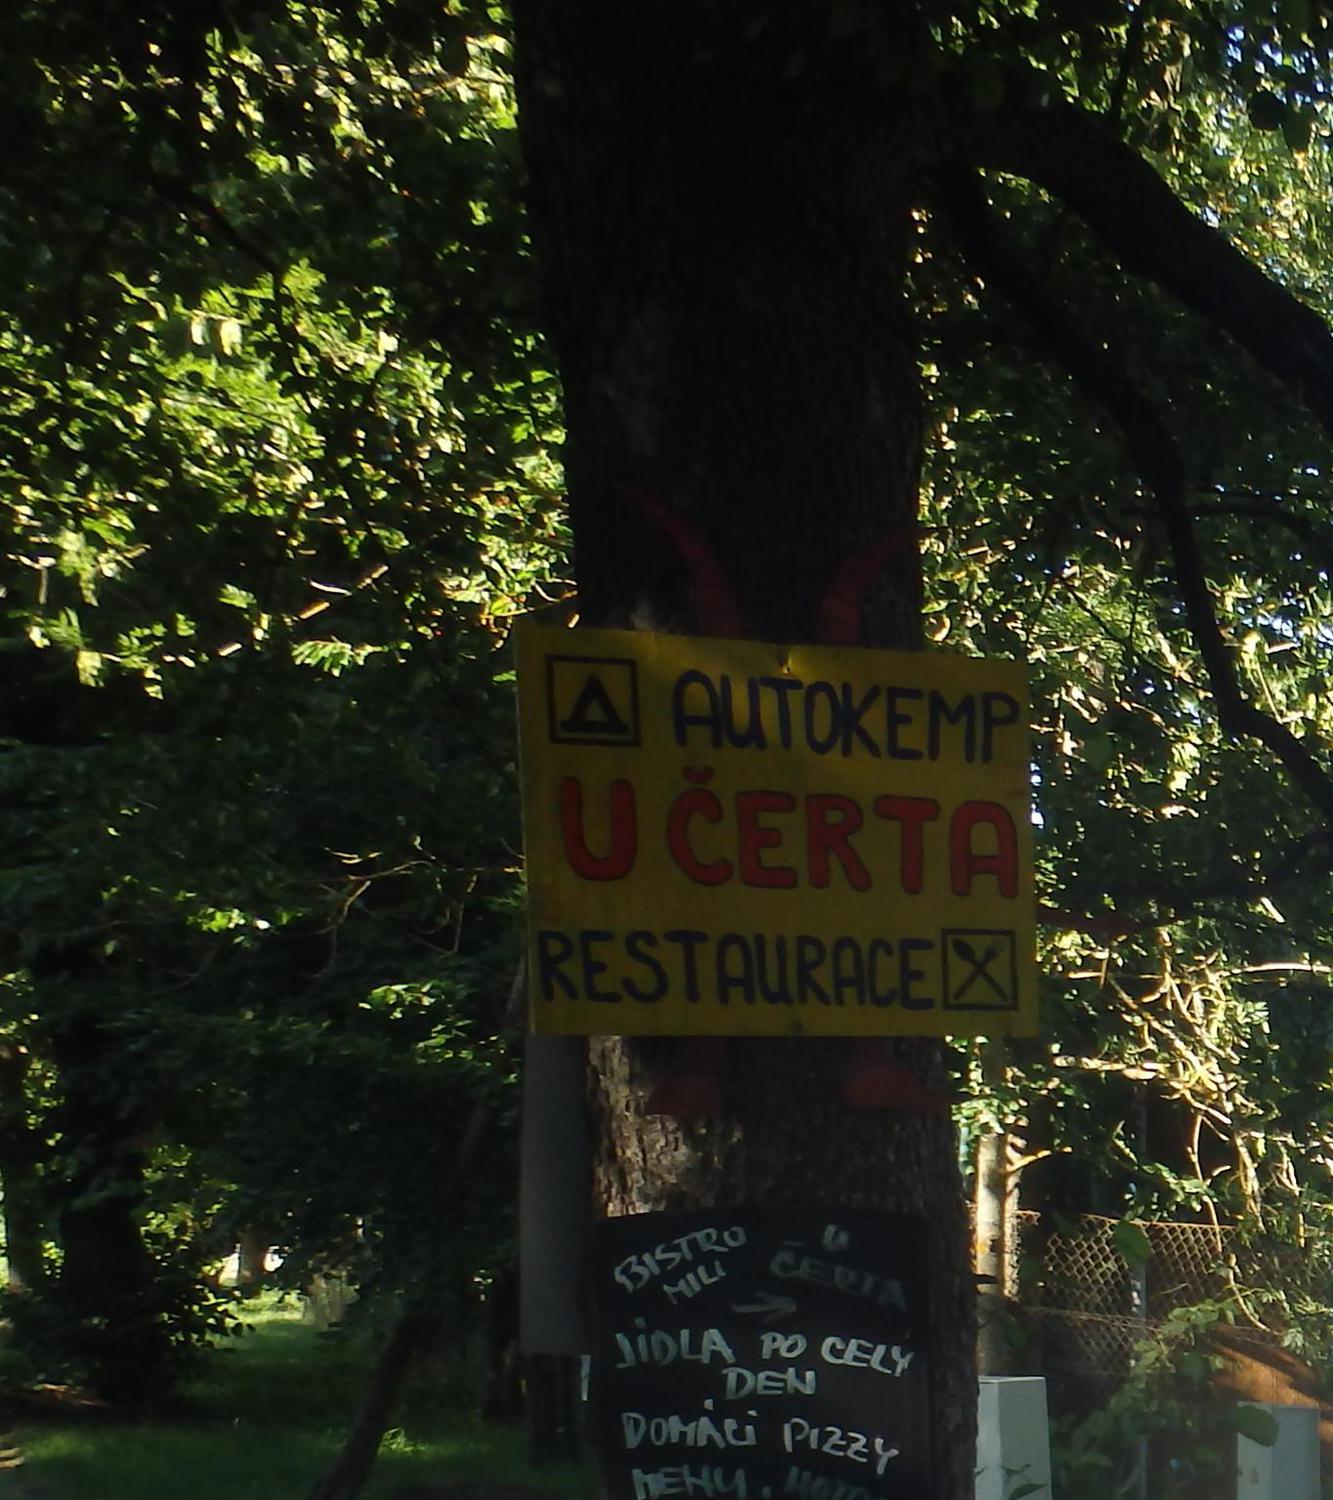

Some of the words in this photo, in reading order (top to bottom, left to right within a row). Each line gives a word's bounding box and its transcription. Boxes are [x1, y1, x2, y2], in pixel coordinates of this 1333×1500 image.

[672, 670, 1020, 764] AUTOKEMP
[559, 776, 640, 883] U
[667, 765, 1020, 899] ČERTA
[537, 929, 936, 1011] RESTAURACE
[613, 1225, 748, 1294] BISTRO
[760, 1331, 808, 1360] PO
[721, 1366, 818, 1400] DEN
[783, 1416, 900, 1477] PIZZY
